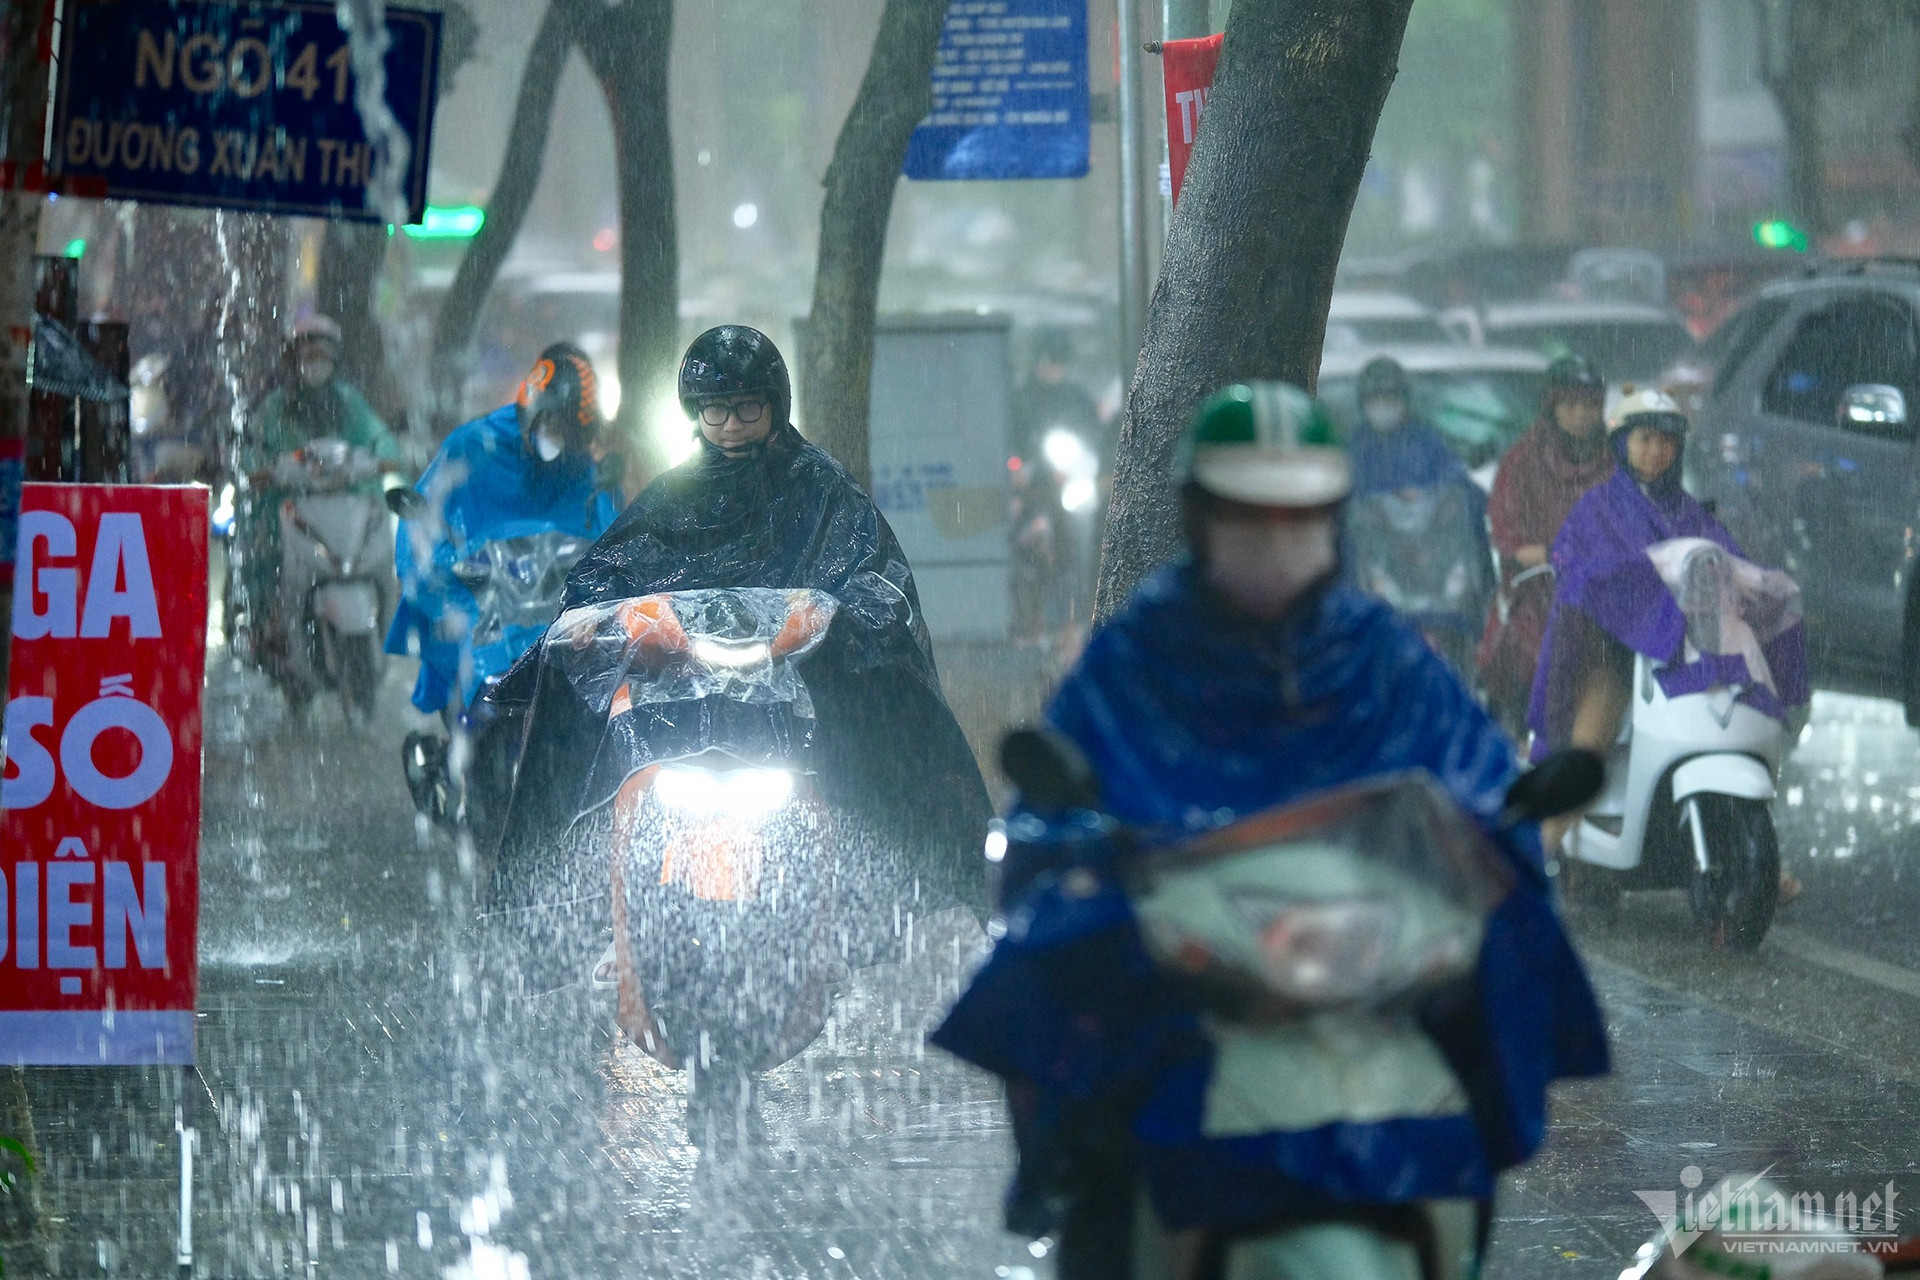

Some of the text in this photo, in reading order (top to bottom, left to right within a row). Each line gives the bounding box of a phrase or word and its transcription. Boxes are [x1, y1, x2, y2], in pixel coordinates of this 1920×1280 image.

[134, 17, 351, 103] NGÕ 41
[11, 510, 163, 639] GA
[0, 673, 174, 809] SỐ
[0, 836, 166, 994] IỆN
